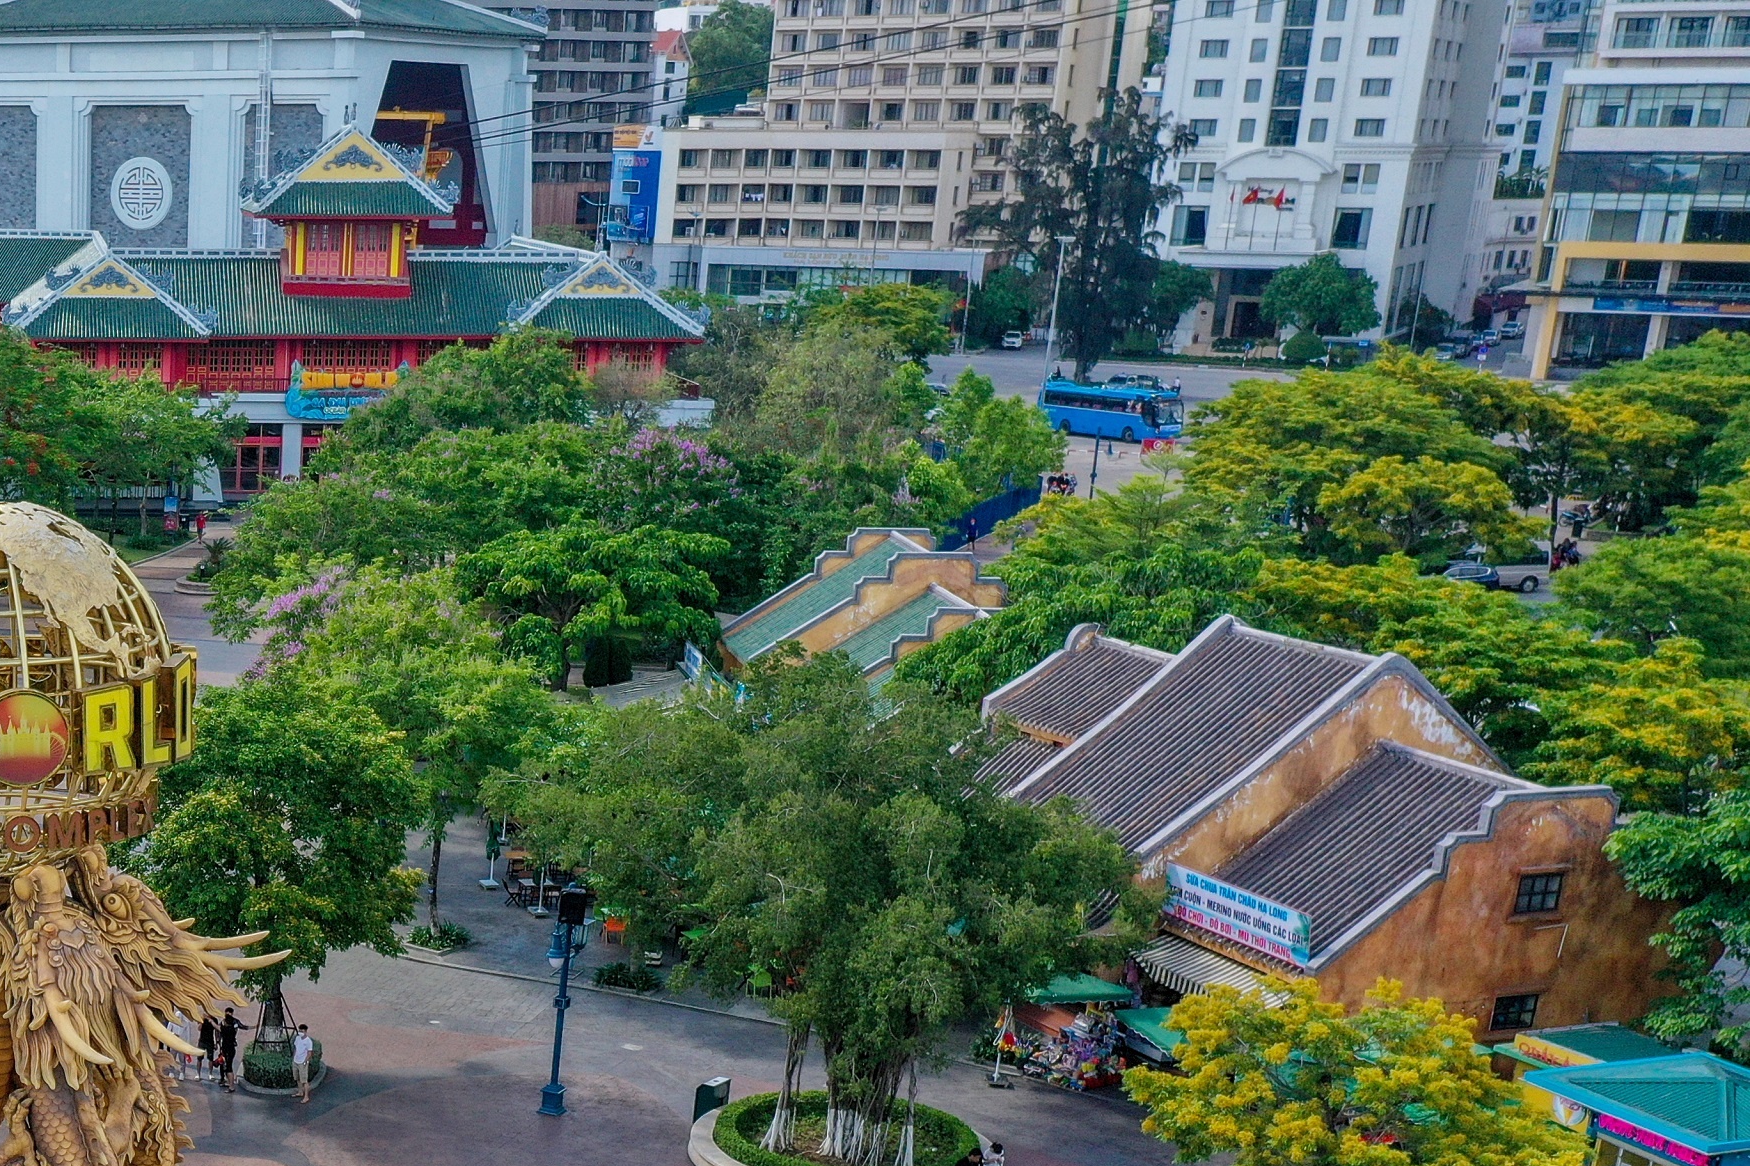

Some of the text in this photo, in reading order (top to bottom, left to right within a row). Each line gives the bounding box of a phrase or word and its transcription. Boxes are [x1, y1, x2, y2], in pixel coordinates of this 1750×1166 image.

[301, 372, 334, 389] SUN
[1184, 889, 1201, 906] CUỘN
[1206, 898, 1232, 918] MERINO
[1272, 923, 1287, 939] CÁC
[1200, 878, 1217, 894] CHUA
[1219, 884, 1236, 902] TRÂN
[1238, 891, 1256, 910] CHÂU
[1257, 901, 1267, 916] HẠ
[1269, 905, 1288, 922] LONG
[1268, 942, 1291, 959] TRANG
